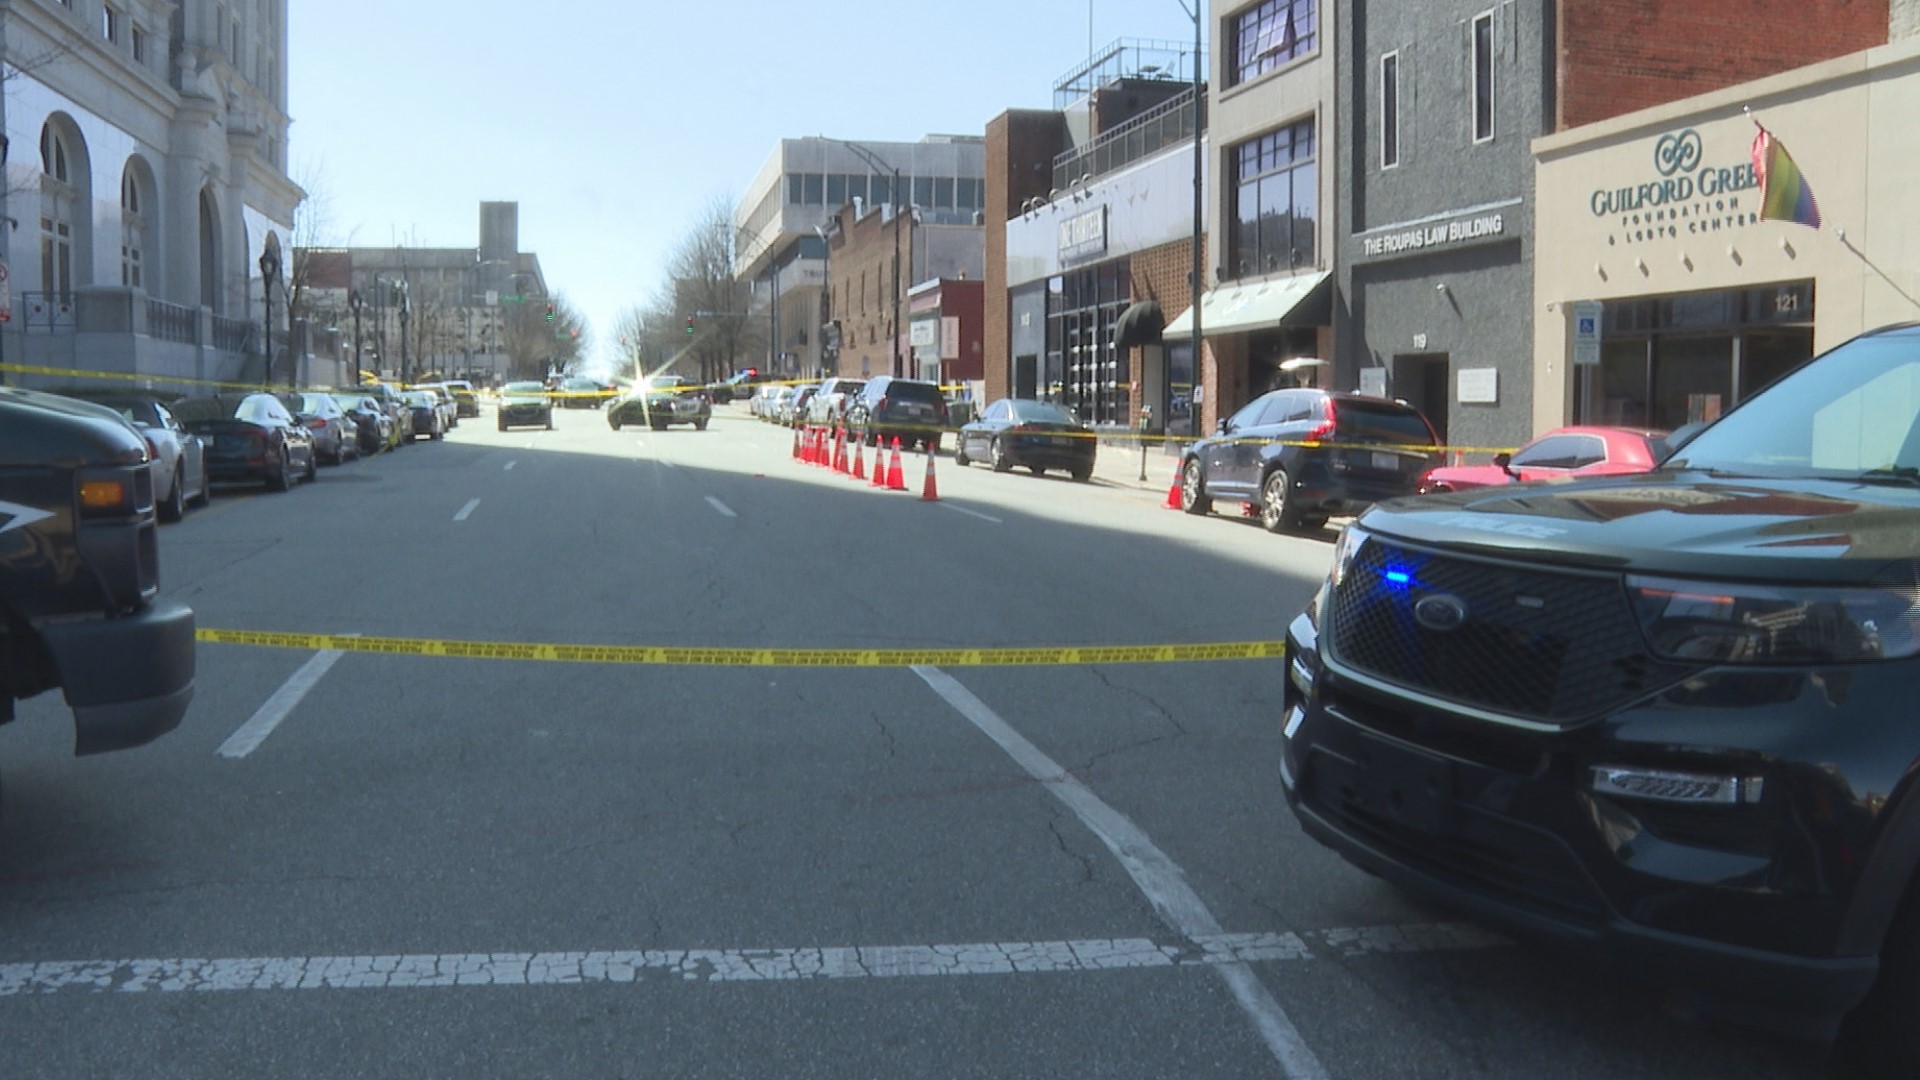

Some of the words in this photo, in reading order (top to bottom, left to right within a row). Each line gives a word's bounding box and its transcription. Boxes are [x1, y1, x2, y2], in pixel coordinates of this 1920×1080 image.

[1591, 176, 1693, 217] GUILFORD
[1698, 163, 1758, 197] GREE
[1622, 197, 1739, 228] FOUNDATION
[1688, 211, 1757, 235] CENTER
[1364, 237, 1384, 256] THE
[1384, 229, 1424, 252] ROUPAS
[1424, 224, 1449, 246] LAW
[1449, 214, 1504, 241] BUILDING
[1775, 294, 1798, 312] 121
[1412, 333, 1427, 349] 119
